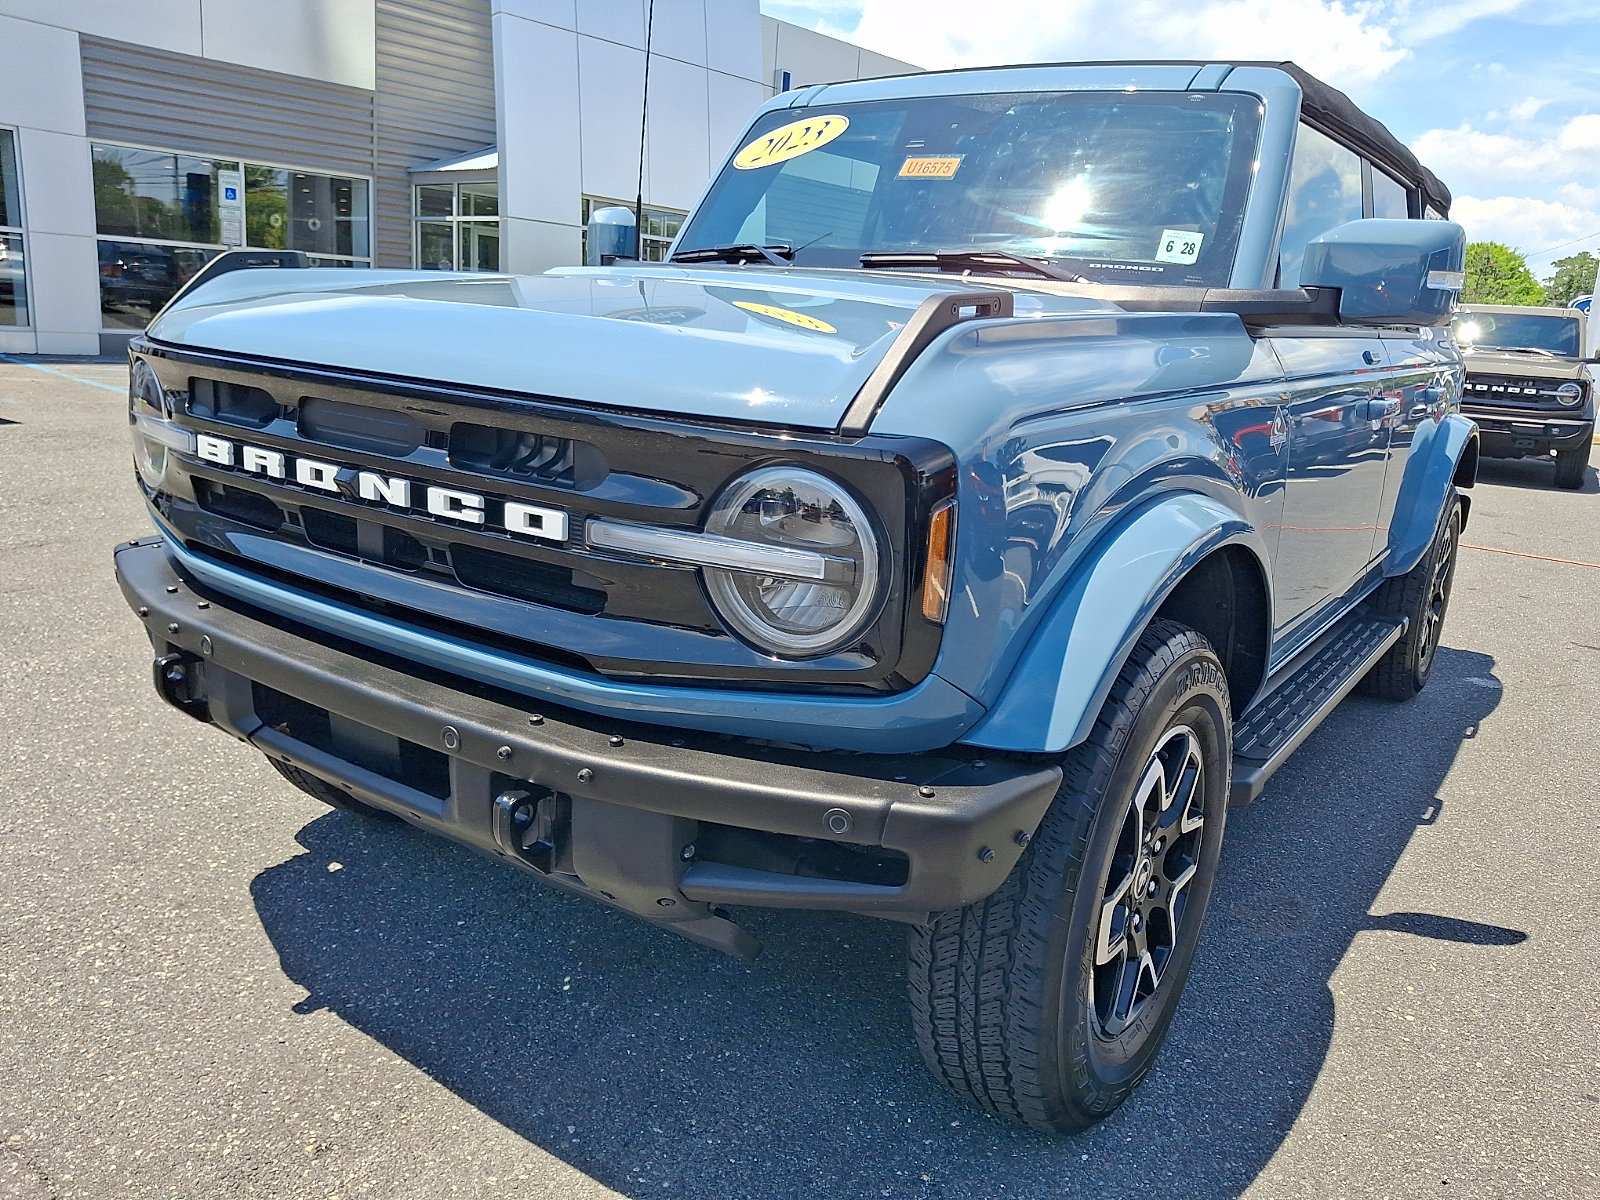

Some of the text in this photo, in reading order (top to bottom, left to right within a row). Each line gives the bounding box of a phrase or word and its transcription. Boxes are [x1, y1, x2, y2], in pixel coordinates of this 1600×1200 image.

[750, 120, 832, 163] 2023
[906, 161, 953, 174] U16575
[1165, 240, 1196, 255] 6 28
[1089, 263, 1164, 272] BRONCO
[1463, 383, 1537, 395] RONCO
[195, 432, 570, 542] BRONCO
